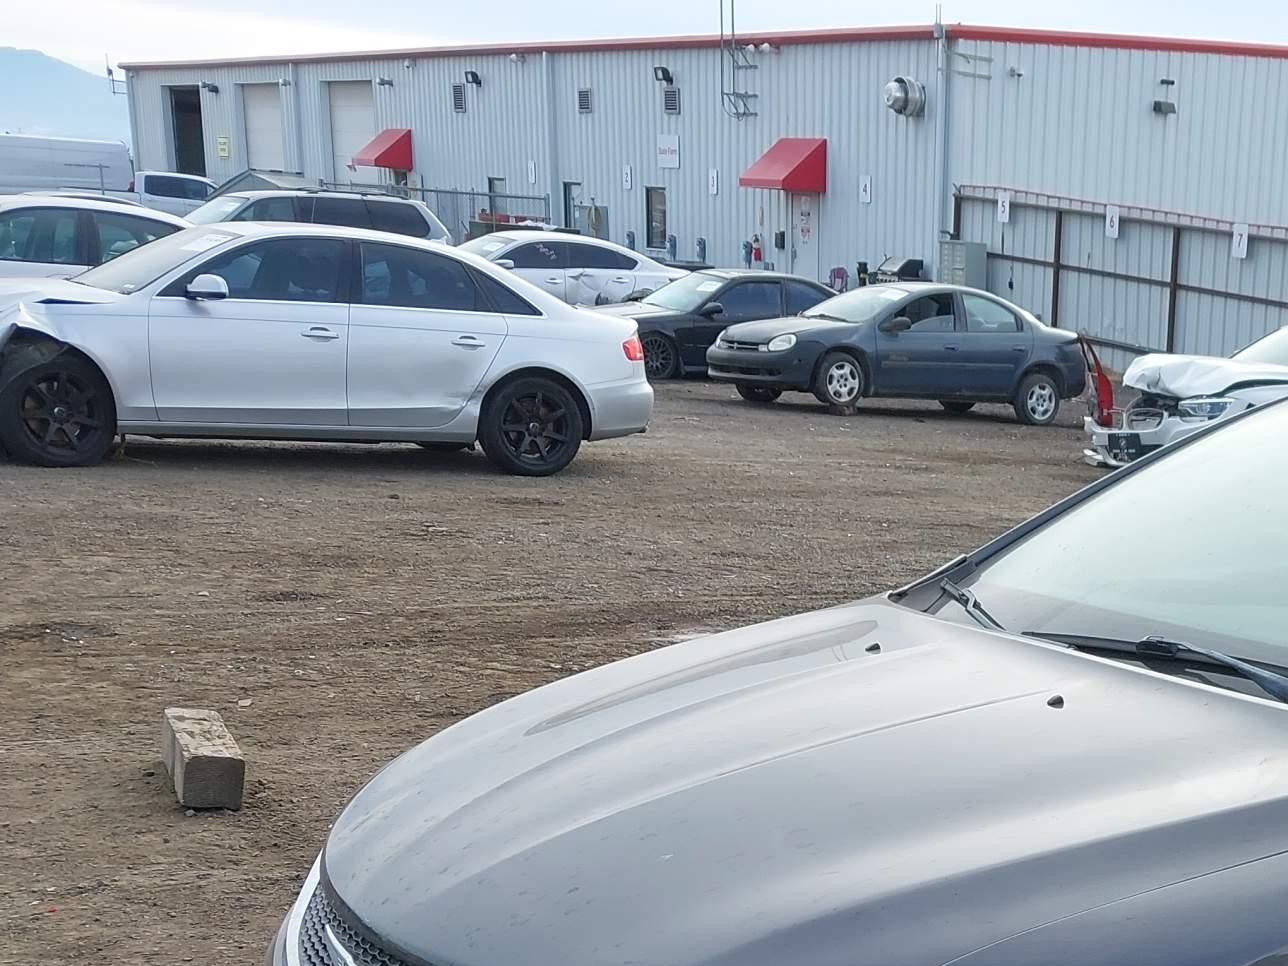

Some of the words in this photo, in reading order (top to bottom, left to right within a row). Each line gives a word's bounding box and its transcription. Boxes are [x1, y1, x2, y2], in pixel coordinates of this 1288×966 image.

[1000, 200, 1007, 214] 5
[1109, 215, 1115, 229] 6
[1237, 233, 1244, 248] 7
